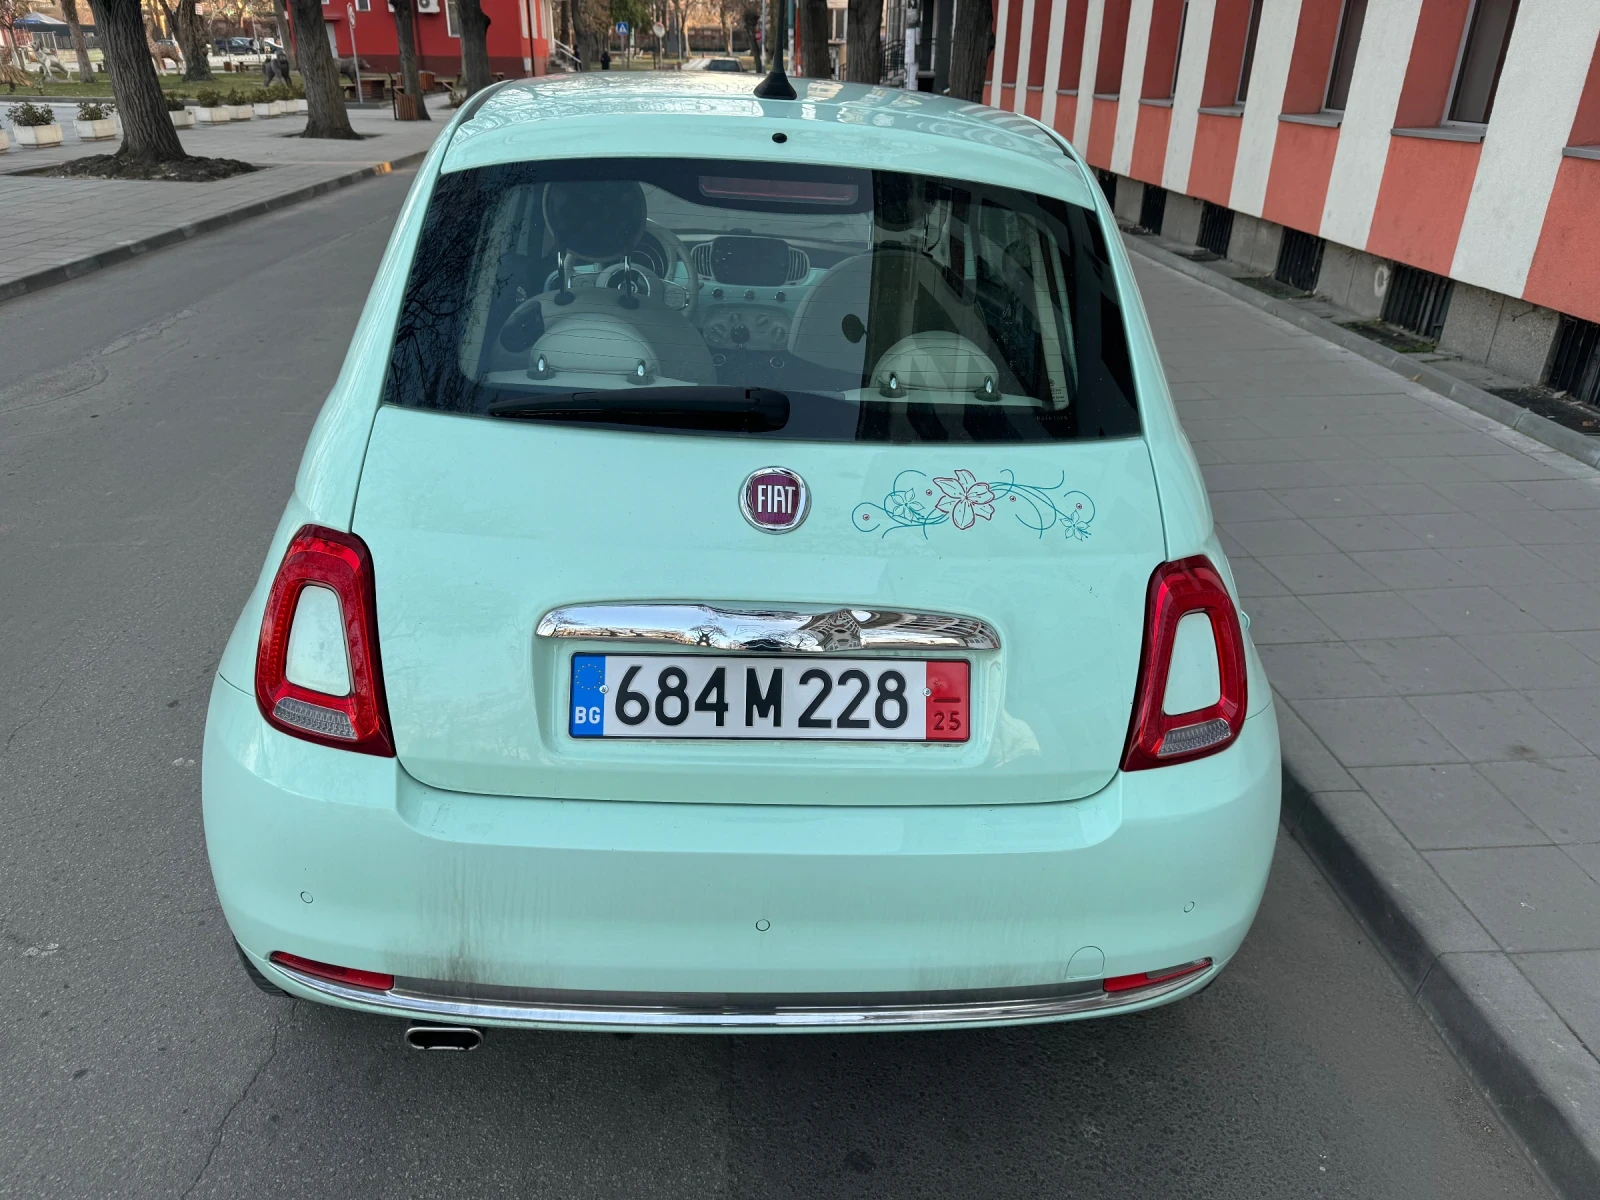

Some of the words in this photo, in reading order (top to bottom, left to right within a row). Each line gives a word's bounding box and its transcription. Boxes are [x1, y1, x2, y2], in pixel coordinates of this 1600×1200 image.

[757, 484, 796, 514] FIAT
[615, 665, 729, 726] 684
[745, 667, 783, 727] M
[797, 668, 909, 729] 228
[574, 706, 601, 725] BG
[932, 710, 961, 731] 25
